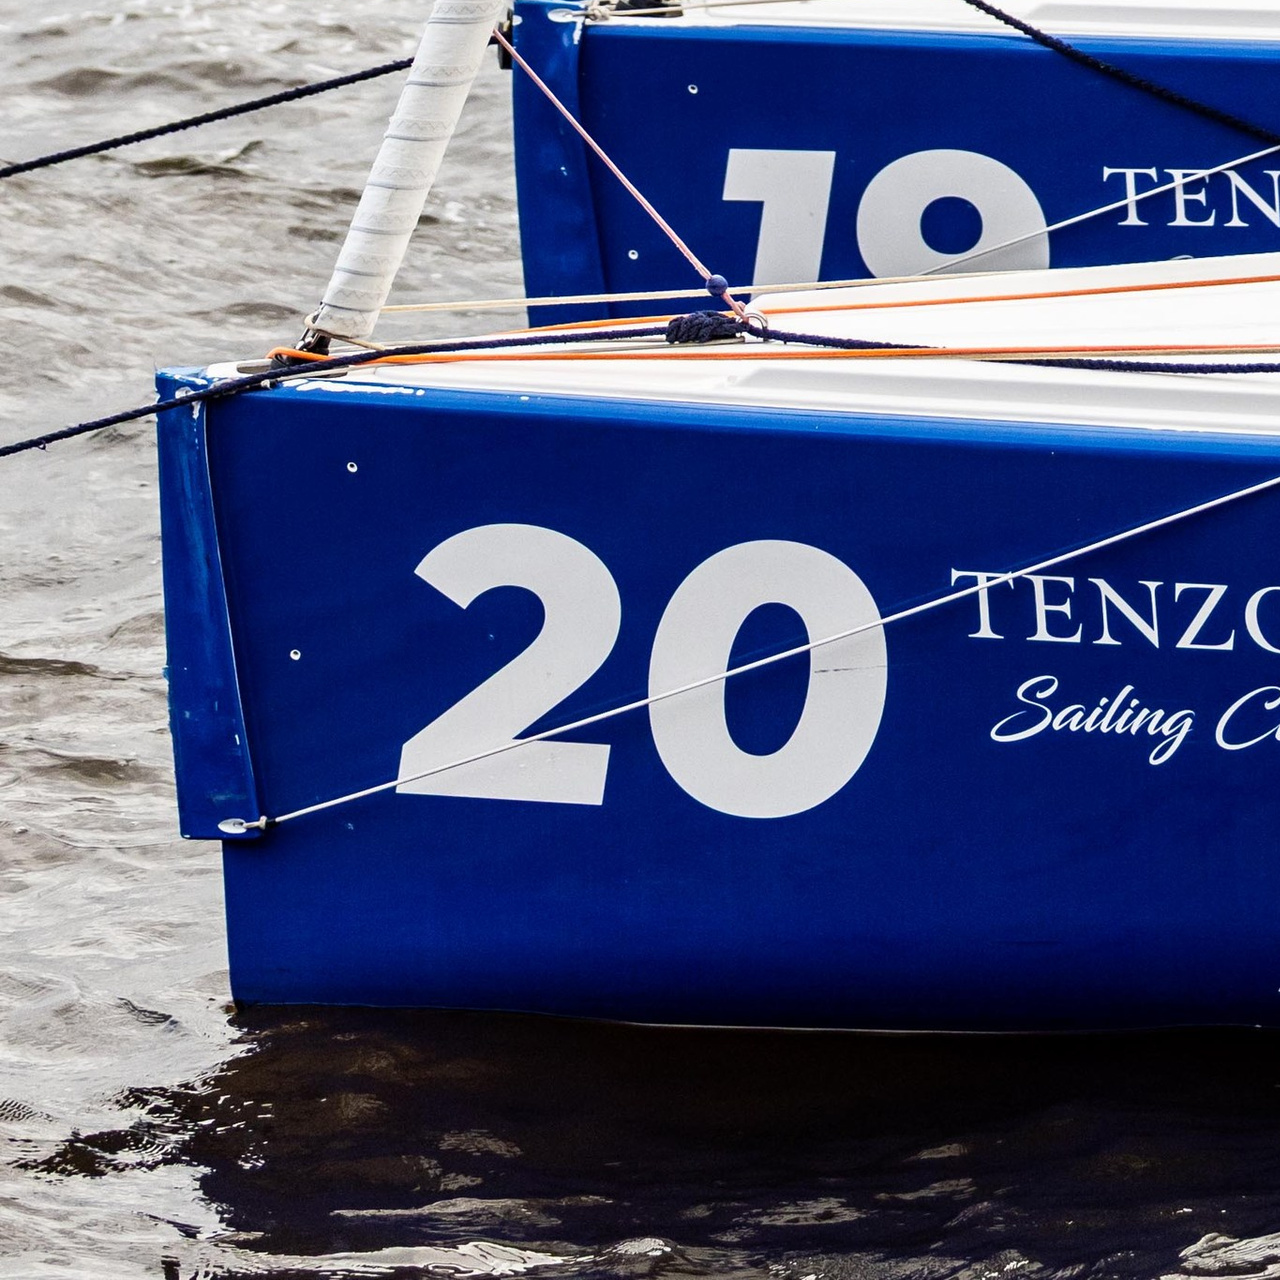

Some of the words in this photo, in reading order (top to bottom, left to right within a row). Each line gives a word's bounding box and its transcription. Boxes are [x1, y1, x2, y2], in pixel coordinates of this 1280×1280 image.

[722, 148, 1051, 302] 19
[396, 523, 888, 819] 20
[990, 675, 1194, 766] Sailing
